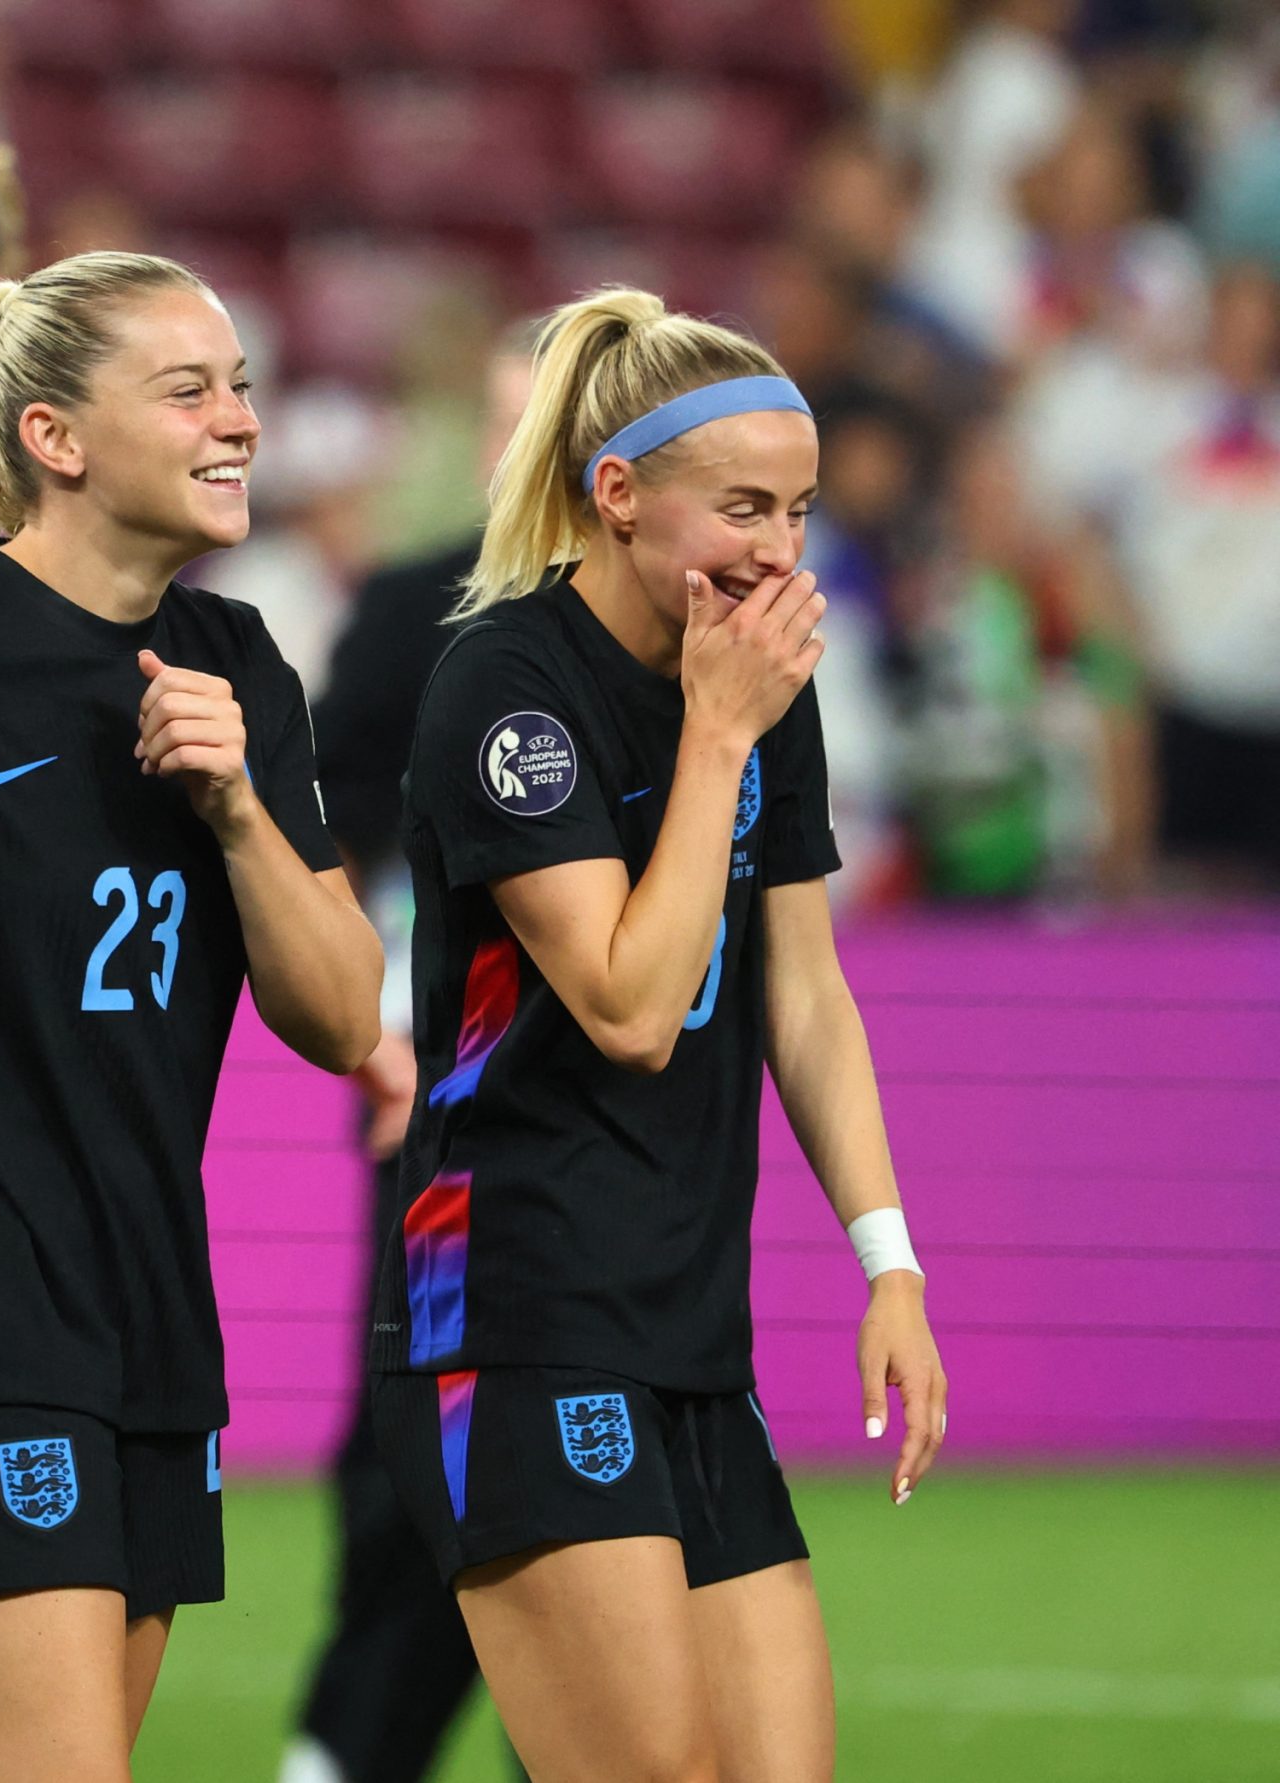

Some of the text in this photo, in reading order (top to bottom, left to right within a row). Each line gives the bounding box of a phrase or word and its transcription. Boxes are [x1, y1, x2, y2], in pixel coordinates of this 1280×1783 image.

[528, 737, 556, 750] UEFA
[518, 750, 568, 764] EUROPEAN
[517, 759, 572, 774] CHAMPIONS
[531, 772, 564, 785] 2022
[81, 866, 187, 1011] 23
